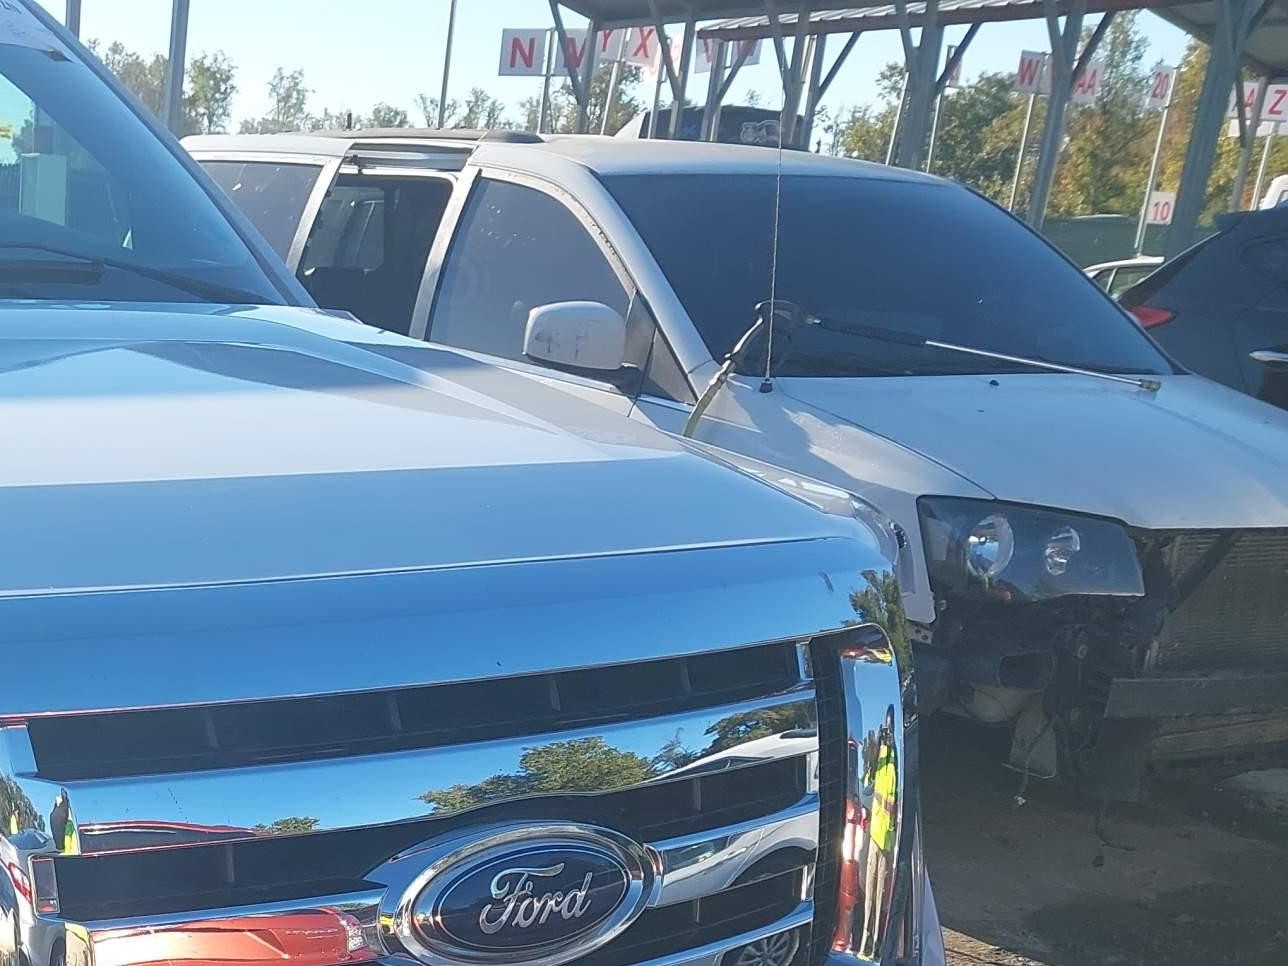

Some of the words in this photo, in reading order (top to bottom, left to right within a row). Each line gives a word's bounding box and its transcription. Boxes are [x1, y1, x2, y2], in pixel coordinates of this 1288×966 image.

[510, 37, 536, 68] N
[633, 27, 655, 58] X
[1151, 71, 1170, 100] 20
[1268, 89, 1288, 115] Z
[1153, 201, 1170, 222] 10
[479, 862, 593, 935] Ford
